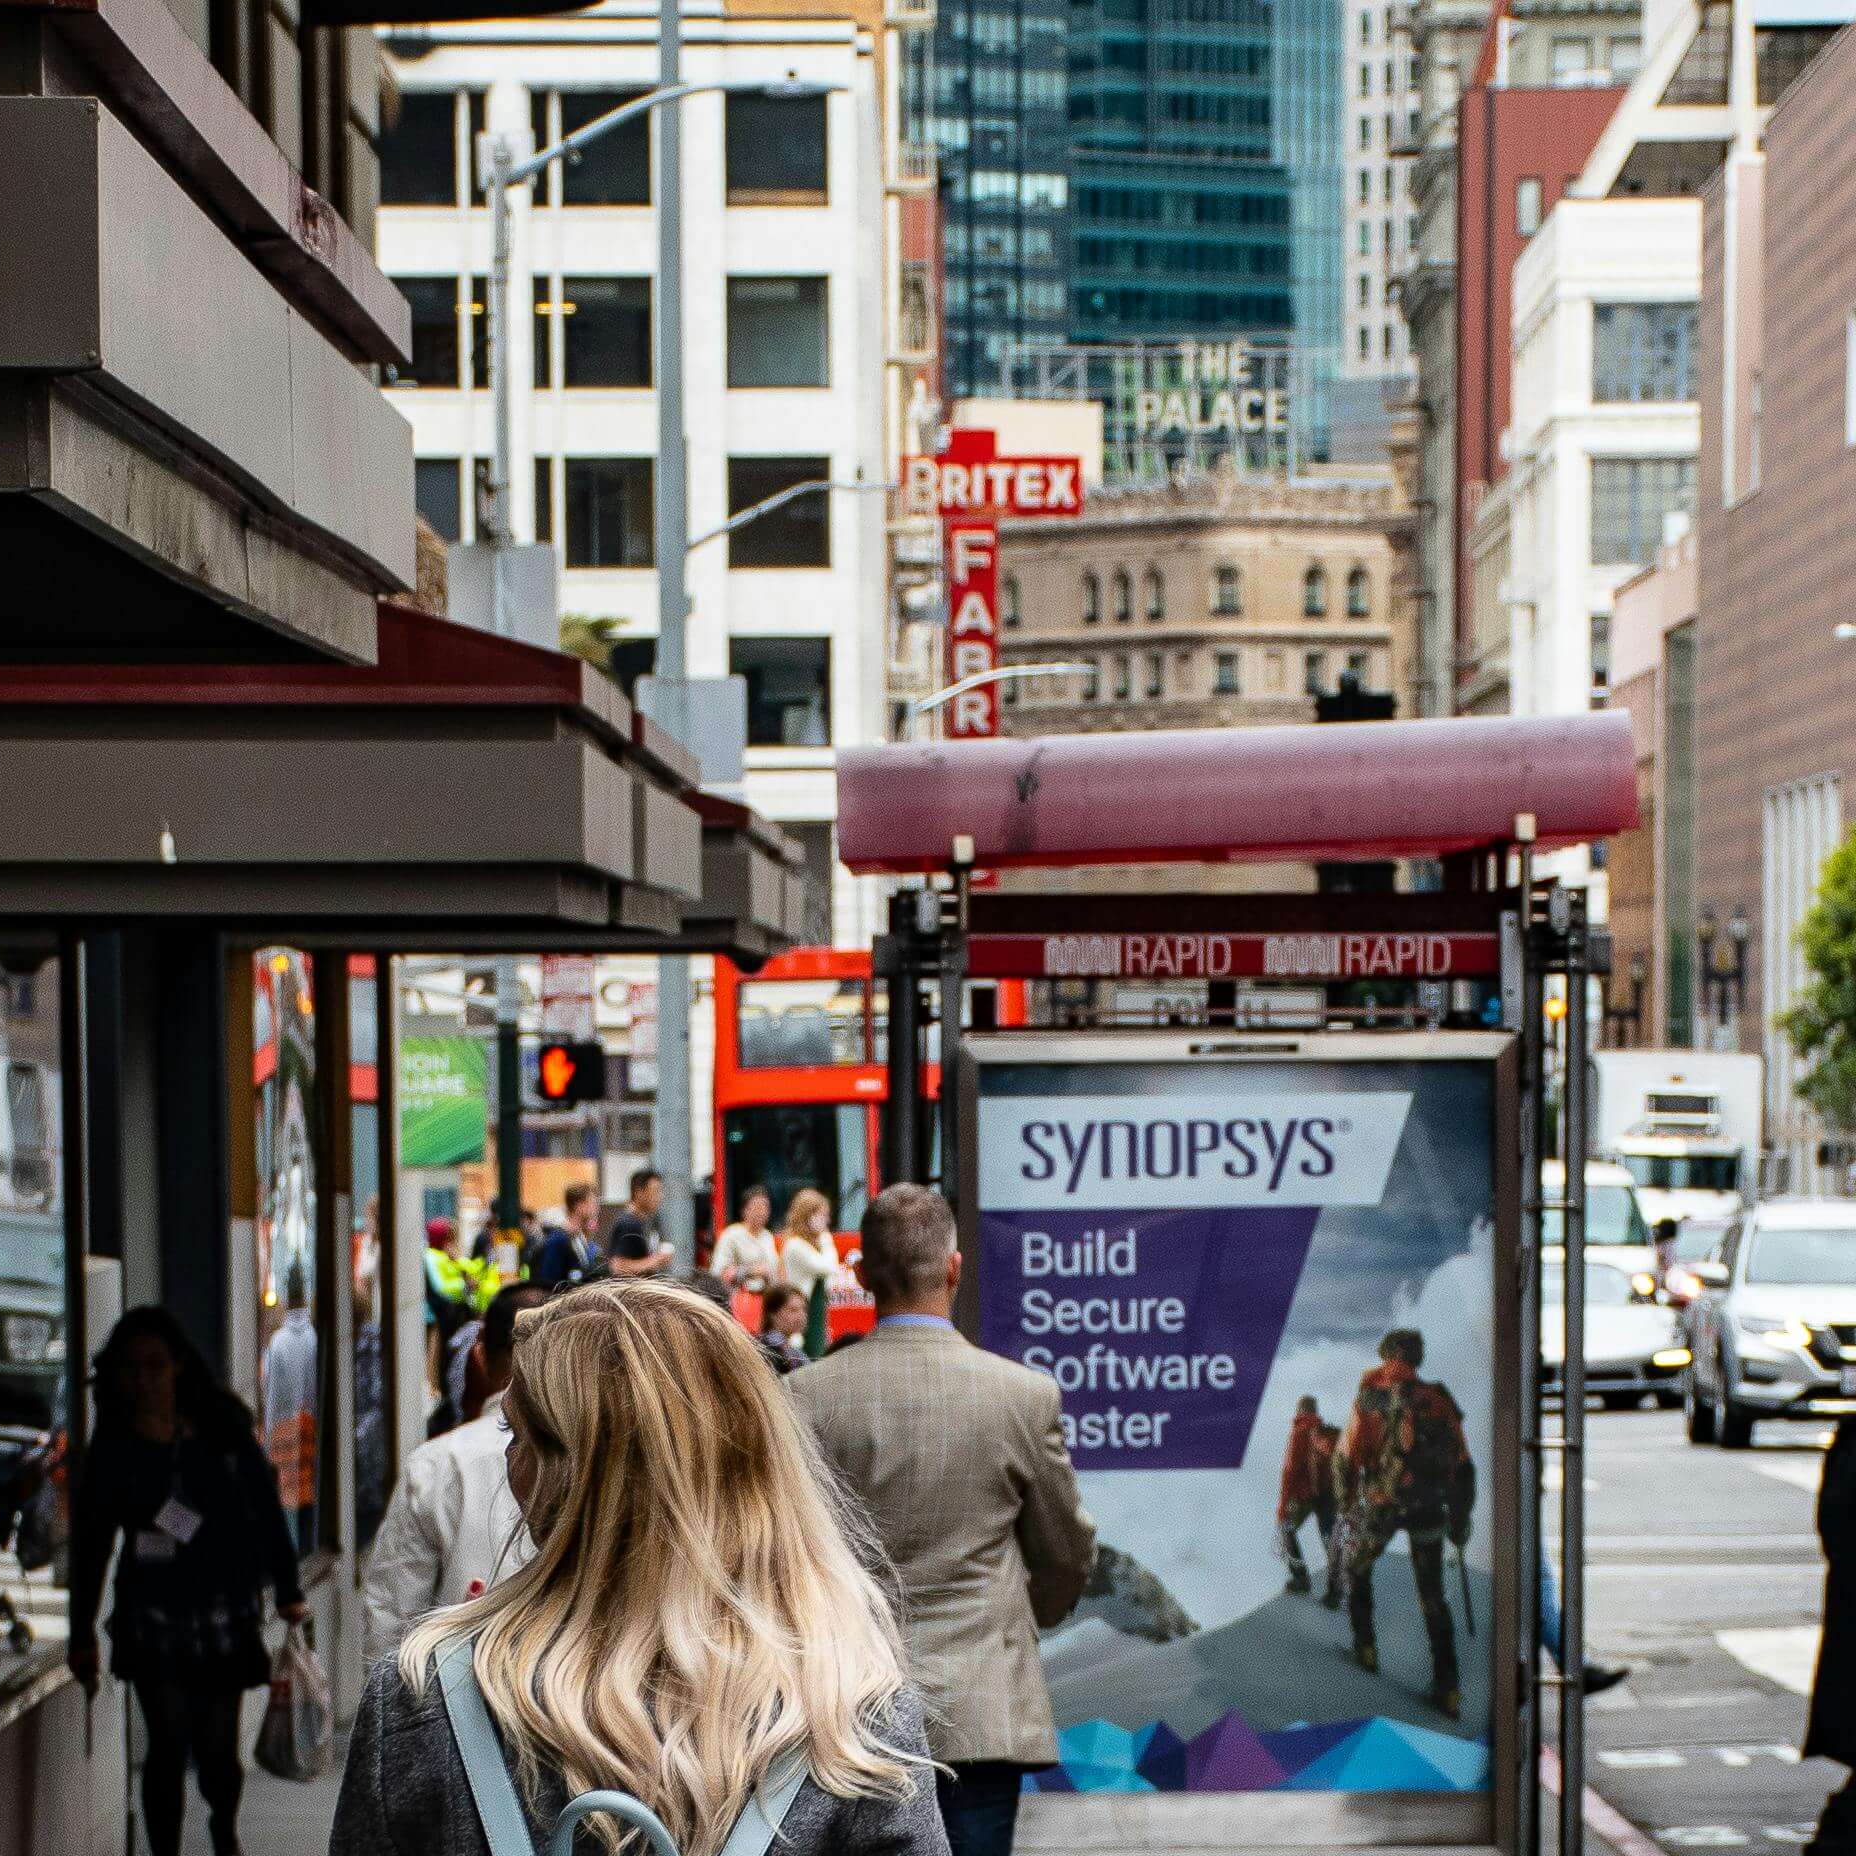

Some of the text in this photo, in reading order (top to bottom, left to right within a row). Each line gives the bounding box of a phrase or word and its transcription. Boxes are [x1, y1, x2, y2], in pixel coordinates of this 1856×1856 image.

[1179, 340, 1251, 385] THE
[1135, 389, 1289, 432] PALACE
[905, 458, 1079, 512] BRITEX
[1124, 936, 1234, 977] RAPID
[1344, 936, 1454, 977] RAPID
[1022, 1231, 1137, 1278] Build
[1021, 1289, 1186, 1334] Secure
[1022, 1343, 1237, 1391] Software
[1058, 1405, 1172, 1449] aster
